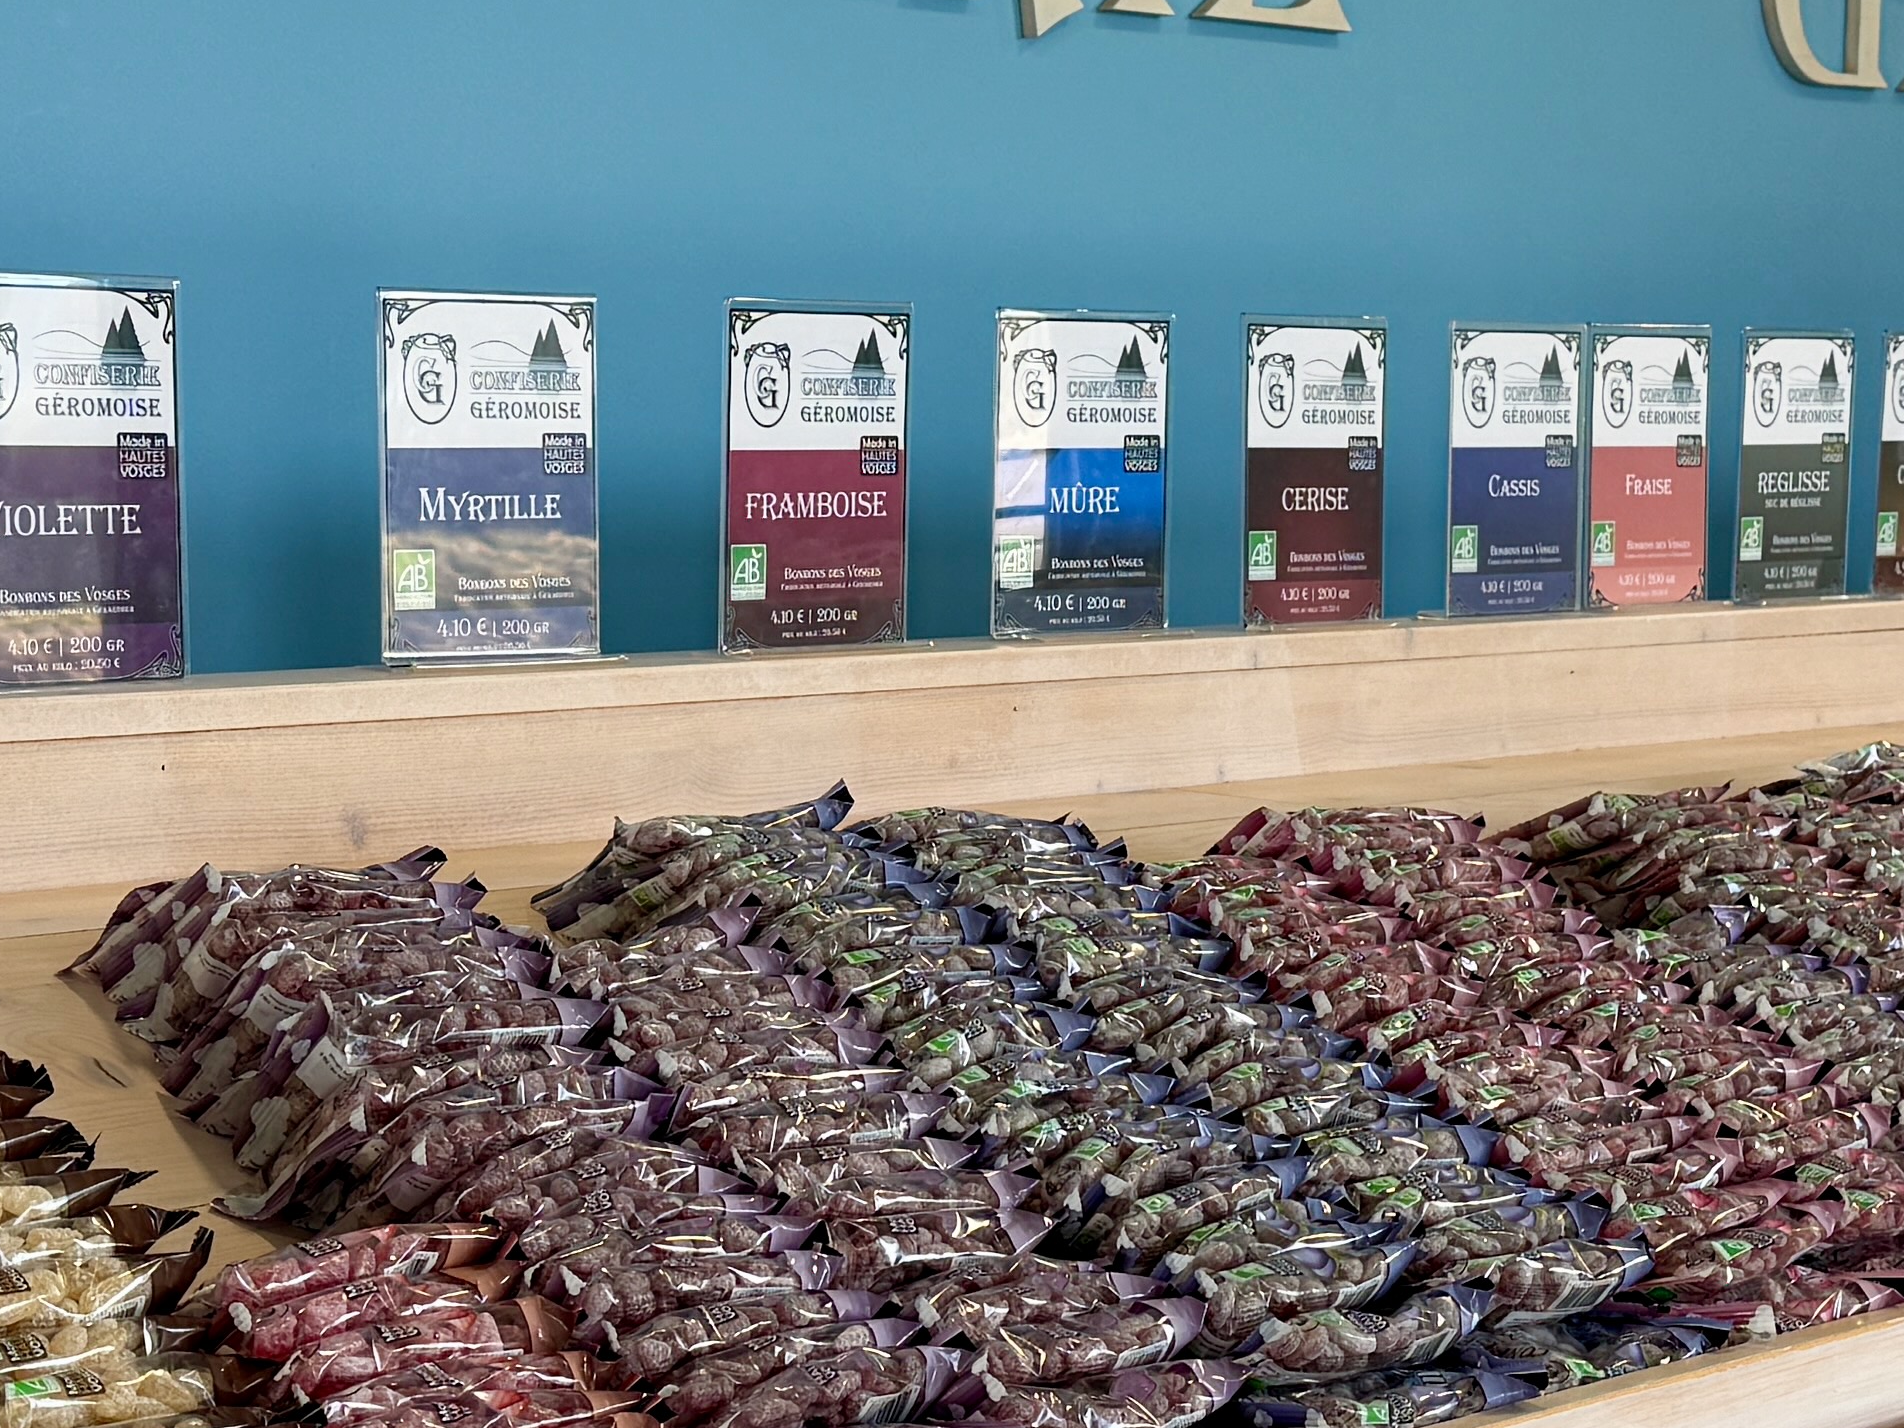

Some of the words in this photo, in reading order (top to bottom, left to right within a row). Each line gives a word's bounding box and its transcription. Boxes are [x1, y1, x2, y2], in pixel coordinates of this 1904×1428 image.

[35, 392, 162, 417] GÉROMOISE
[470, 397, 581, 420] GÉROMOISE
[801, 402, 896, 423] GÉROMOISE
[1067, 403, 1157, 423] GÉROMOISE
[1301, 406, 1375, 425] GÉROMOISE
[1502, 407, 1571, 424] GÉROMOISE
[119, 435, 152, 447] Made
[154, 435, 165, 446] in
[119, 451, 165, 463] HAUTES
[544, 450, 584, 460] HAUTES
[120, 465, 166, 478] VOSGES
[545, 462, 584, 473] VOSGES
[1488, 474, 1540, 498] CASSIS
[1757, 471, 1830, 495] REGLISSE
[419, 487, 561, 522] MYRTILLE
[745, 491, 887, 521] FRAMBOISE
[1049, 481, 1120, 514] MÛRE
[1281, 487, 1349, 512] CERISE
[85, 586, 131, 602] VOSGES
[817, 608, 841, 622] 200
[437, 618, 471, 637] 4.10
[502, 619, 530, 635] 200
[8, 639, 39, 656] 4.10
[70, 636, 102, 653] 200
